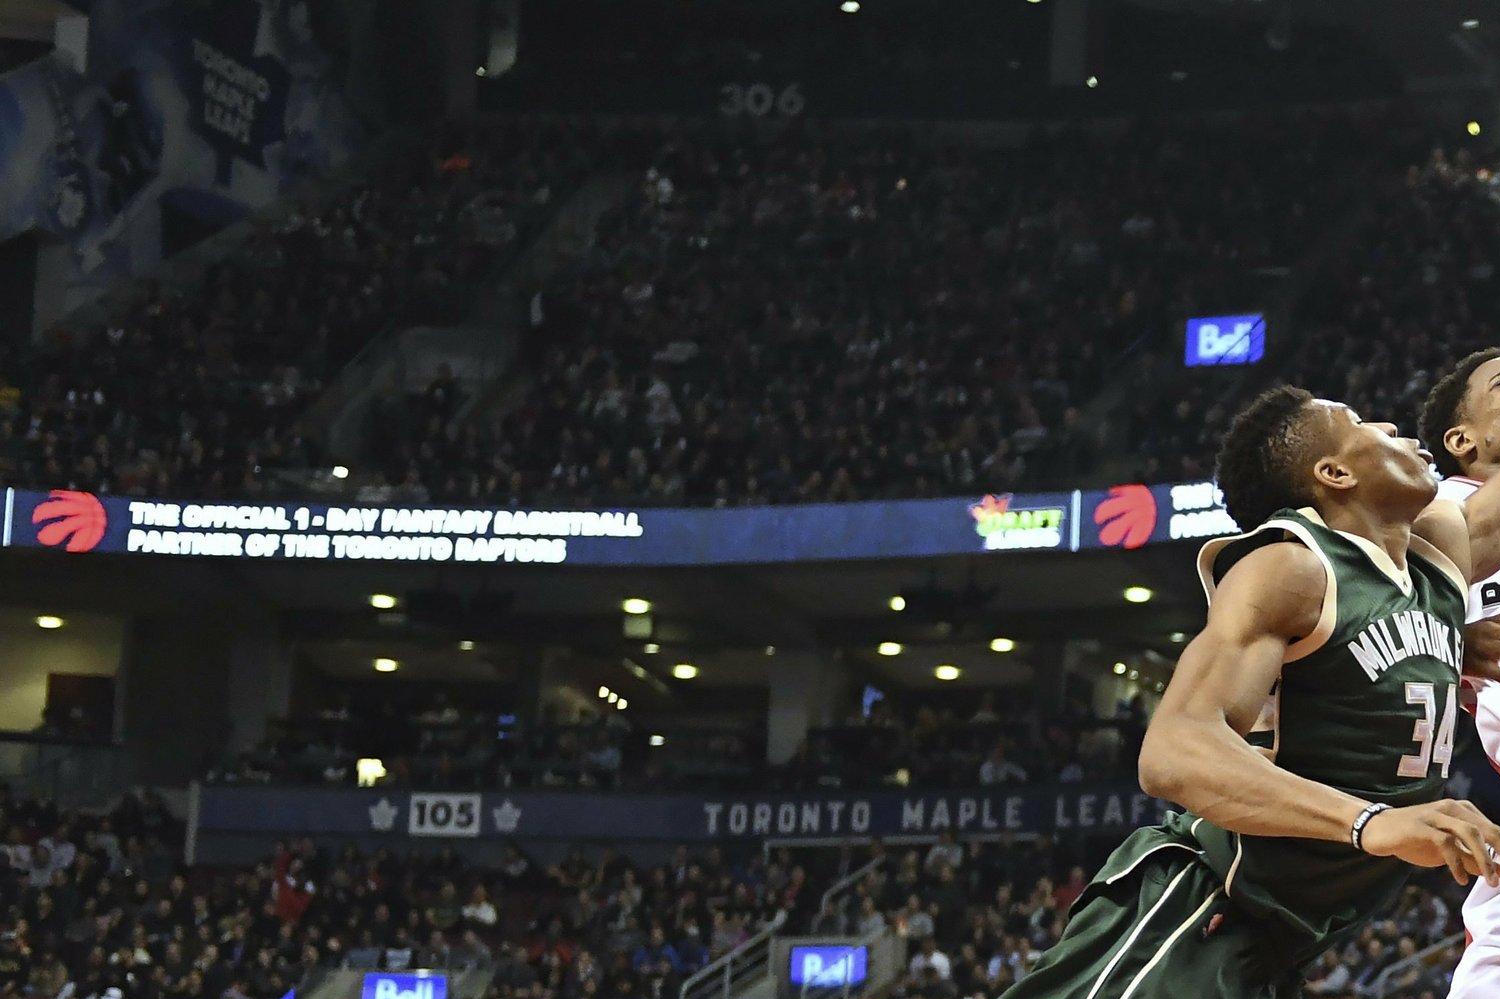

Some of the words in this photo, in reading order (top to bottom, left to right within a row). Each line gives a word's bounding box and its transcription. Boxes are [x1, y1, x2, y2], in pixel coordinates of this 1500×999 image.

[720, 83, 804, 117] 306
[128, 501, 181, 527] THE
[182, 504, 291, 530] OFFICIAL
[294, 507, 310, 531] 1
[326, 507, 380, 532] DAY
[381, 508, 493, 534] FANTASY
[493, 510, 644, 537] BASKETBALL
[127, 529, 243, 556] PARTNER
[245, 533, 280, 557] OF
[281, 534, 330, 558] THE
[331, 535, 453, 561] TORONTO
[454, 537, 567, 563] RAPTORS
[1347, 610, 1464, 687] MILWAUKE
[1397, 682, 1457, 779] 34
[416, 801, 475, 828] 105
[704, 802, 870, 835] TORONTO
[903, 797, 1024, 830] MAPLE
